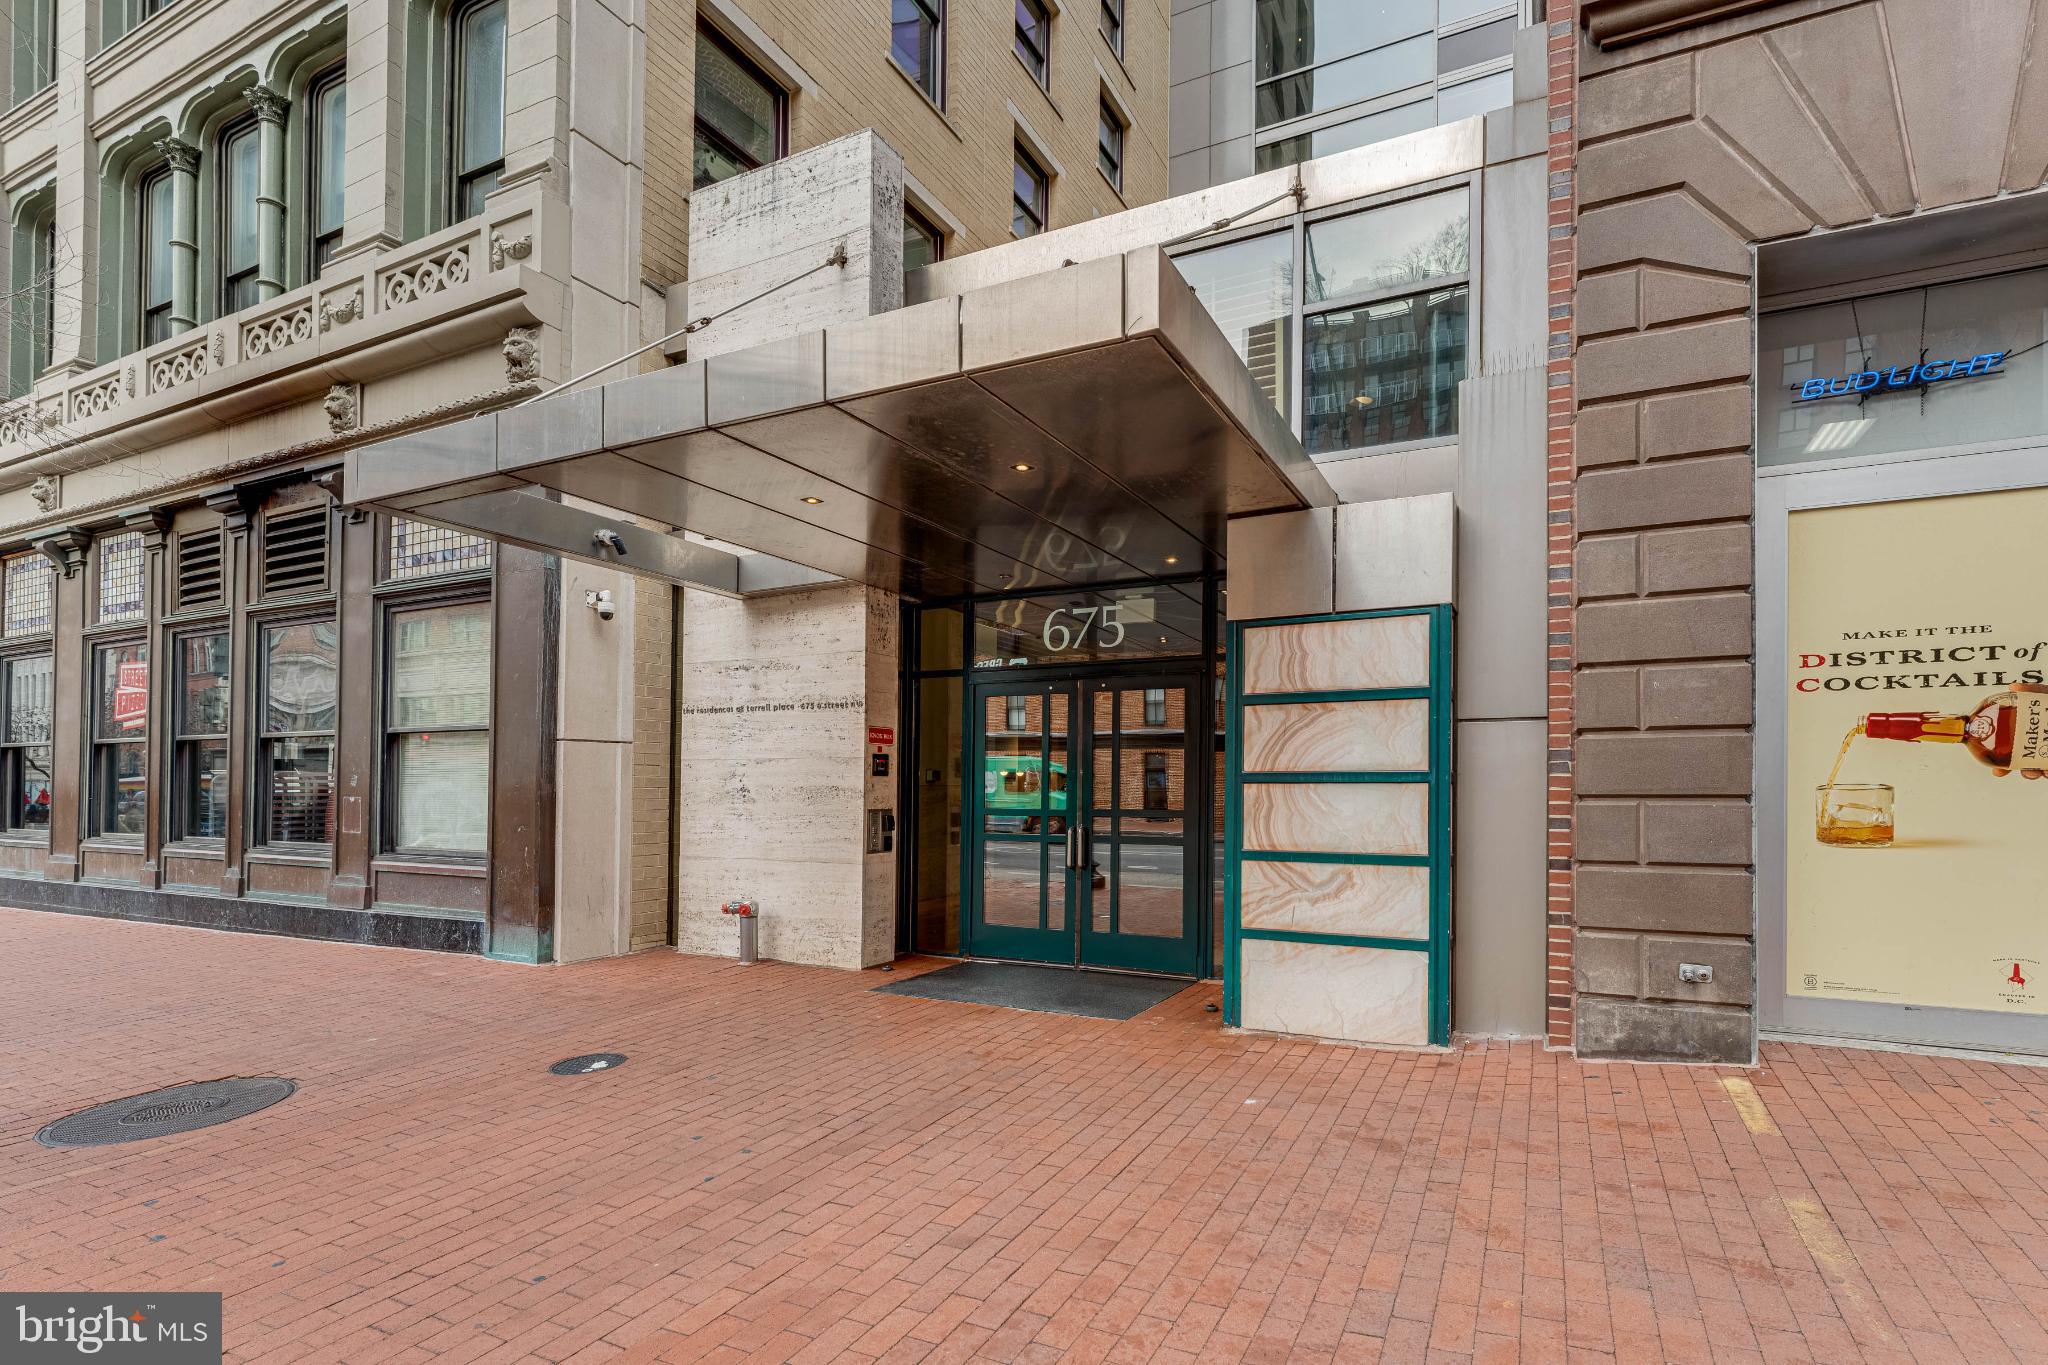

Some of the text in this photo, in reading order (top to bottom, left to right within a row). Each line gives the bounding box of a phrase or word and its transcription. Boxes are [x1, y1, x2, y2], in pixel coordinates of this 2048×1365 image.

[1801, 352, 2004, 399] BUD LIGHT
[1042, 604, 1125, 651] 675
[1842, 624, 1993, 641] MAKE IT THE
[1798, 641, 2048, 669] DISTRICT of
[1796, 669, 2044, 693] COCKTAILS
[773, 703, 795, 712] place
[2021, 699, 2041, 759] Maker's
